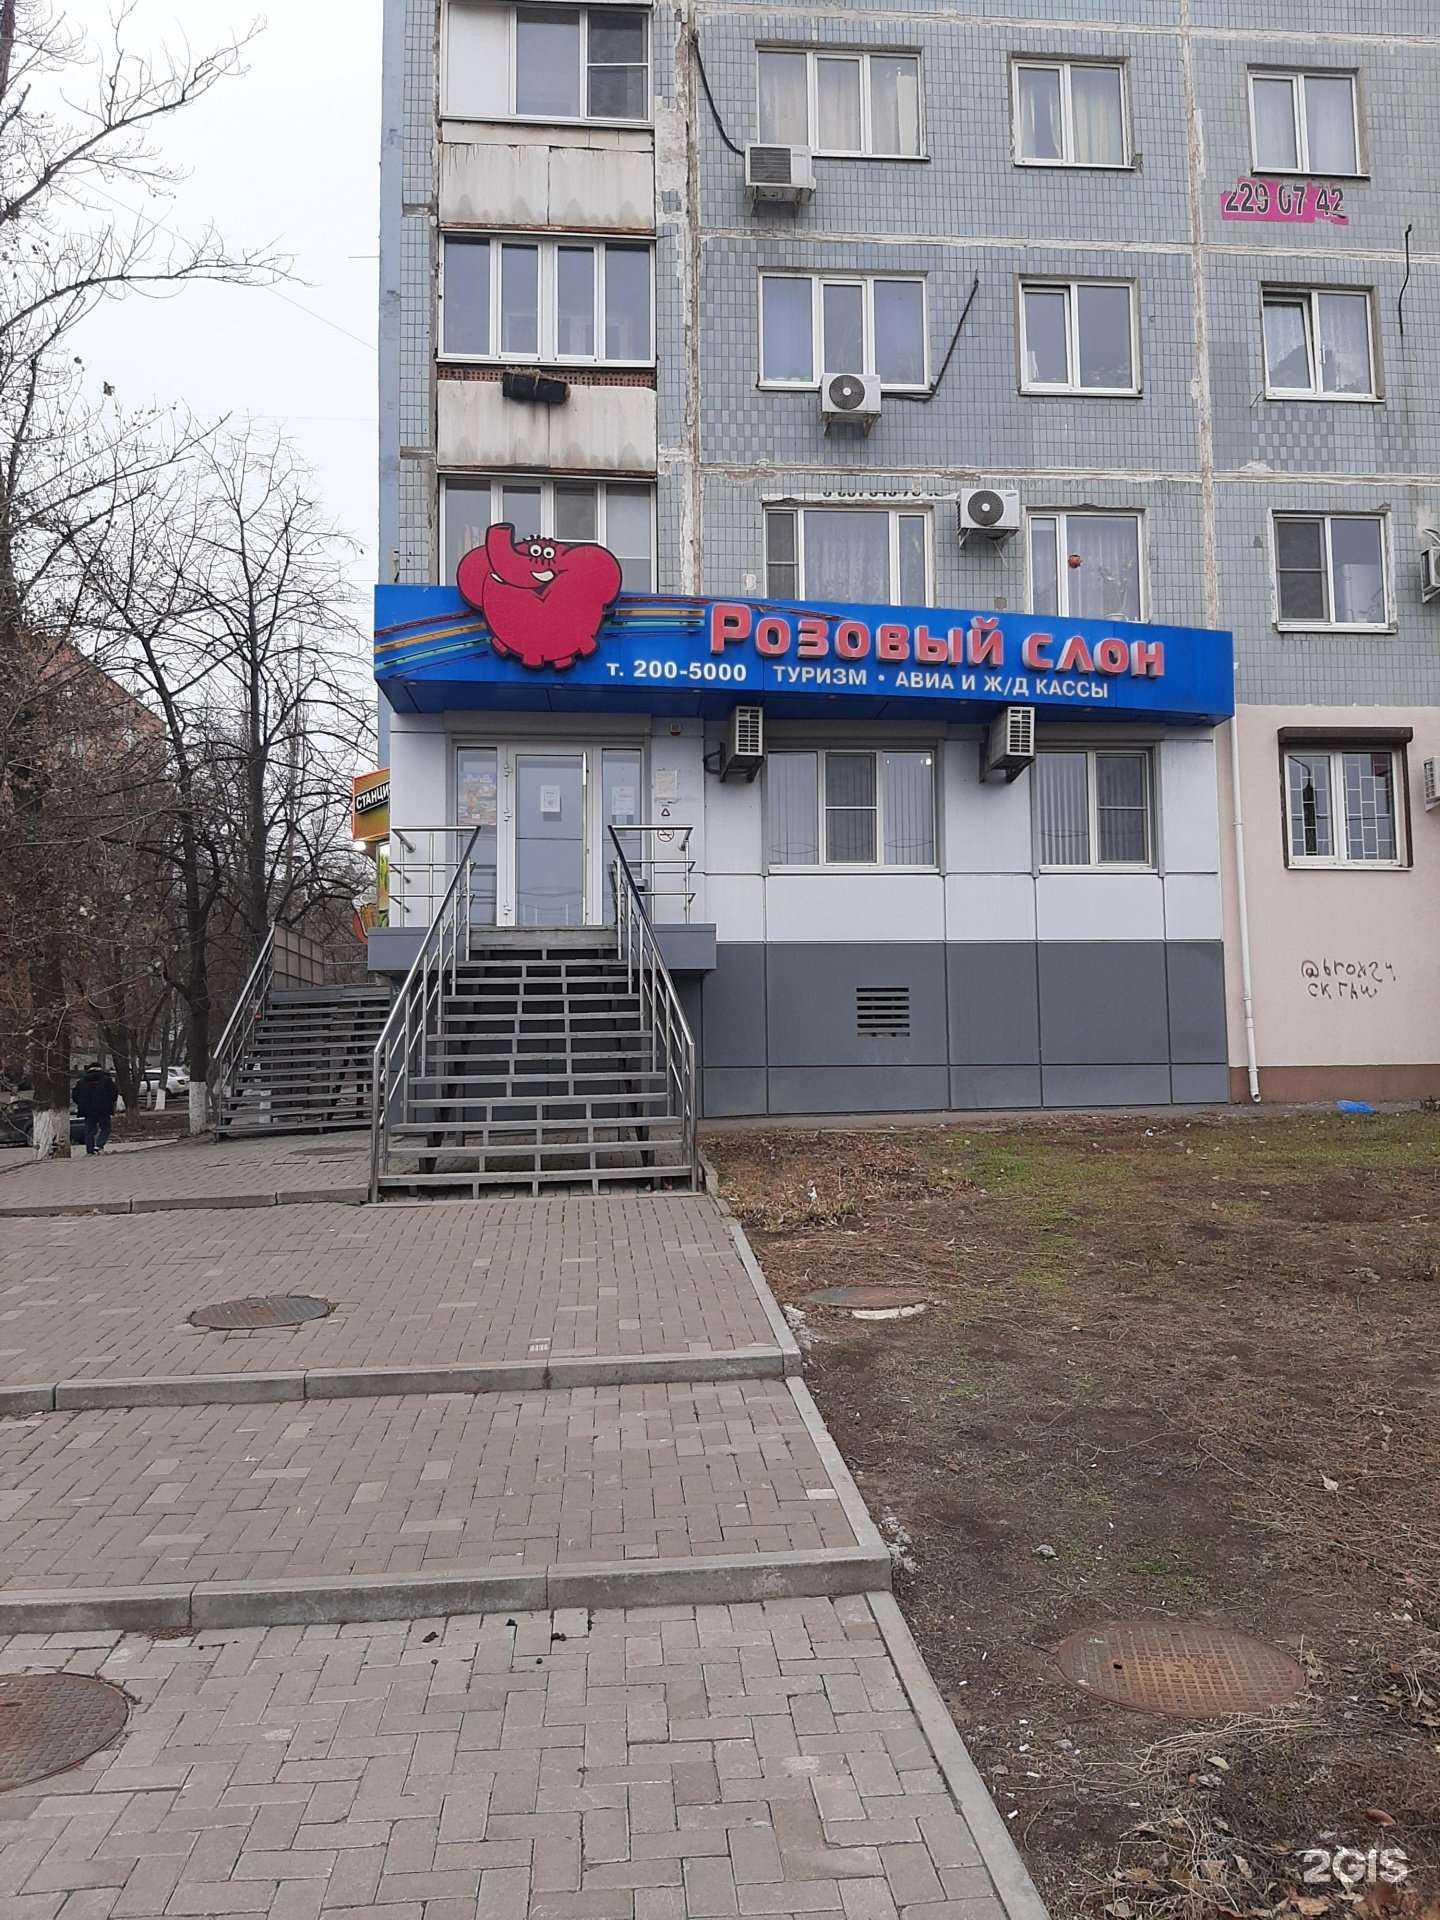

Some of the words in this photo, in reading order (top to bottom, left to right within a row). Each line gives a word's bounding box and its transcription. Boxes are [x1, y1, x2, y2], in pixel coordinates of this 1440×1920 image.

[1226, 183, 1270, 215] 229
[1278, 183, 1306, 216] 07
[1316, 187, 1346, 217] 42
[606, 662, 624, 677] т.
[633, 660, 747, 682] 200-5000
[773, 665, 867, 685] ТУРИЗМ
[895, 670, 954, 690] АВИА
[961, 674, 976, 691] И
[984, 675, 1029, 697] Ж/Д
[1035, 678, 1109, 699] КАССЫ
[356, 783, 391, 810] СТАНЦИ
